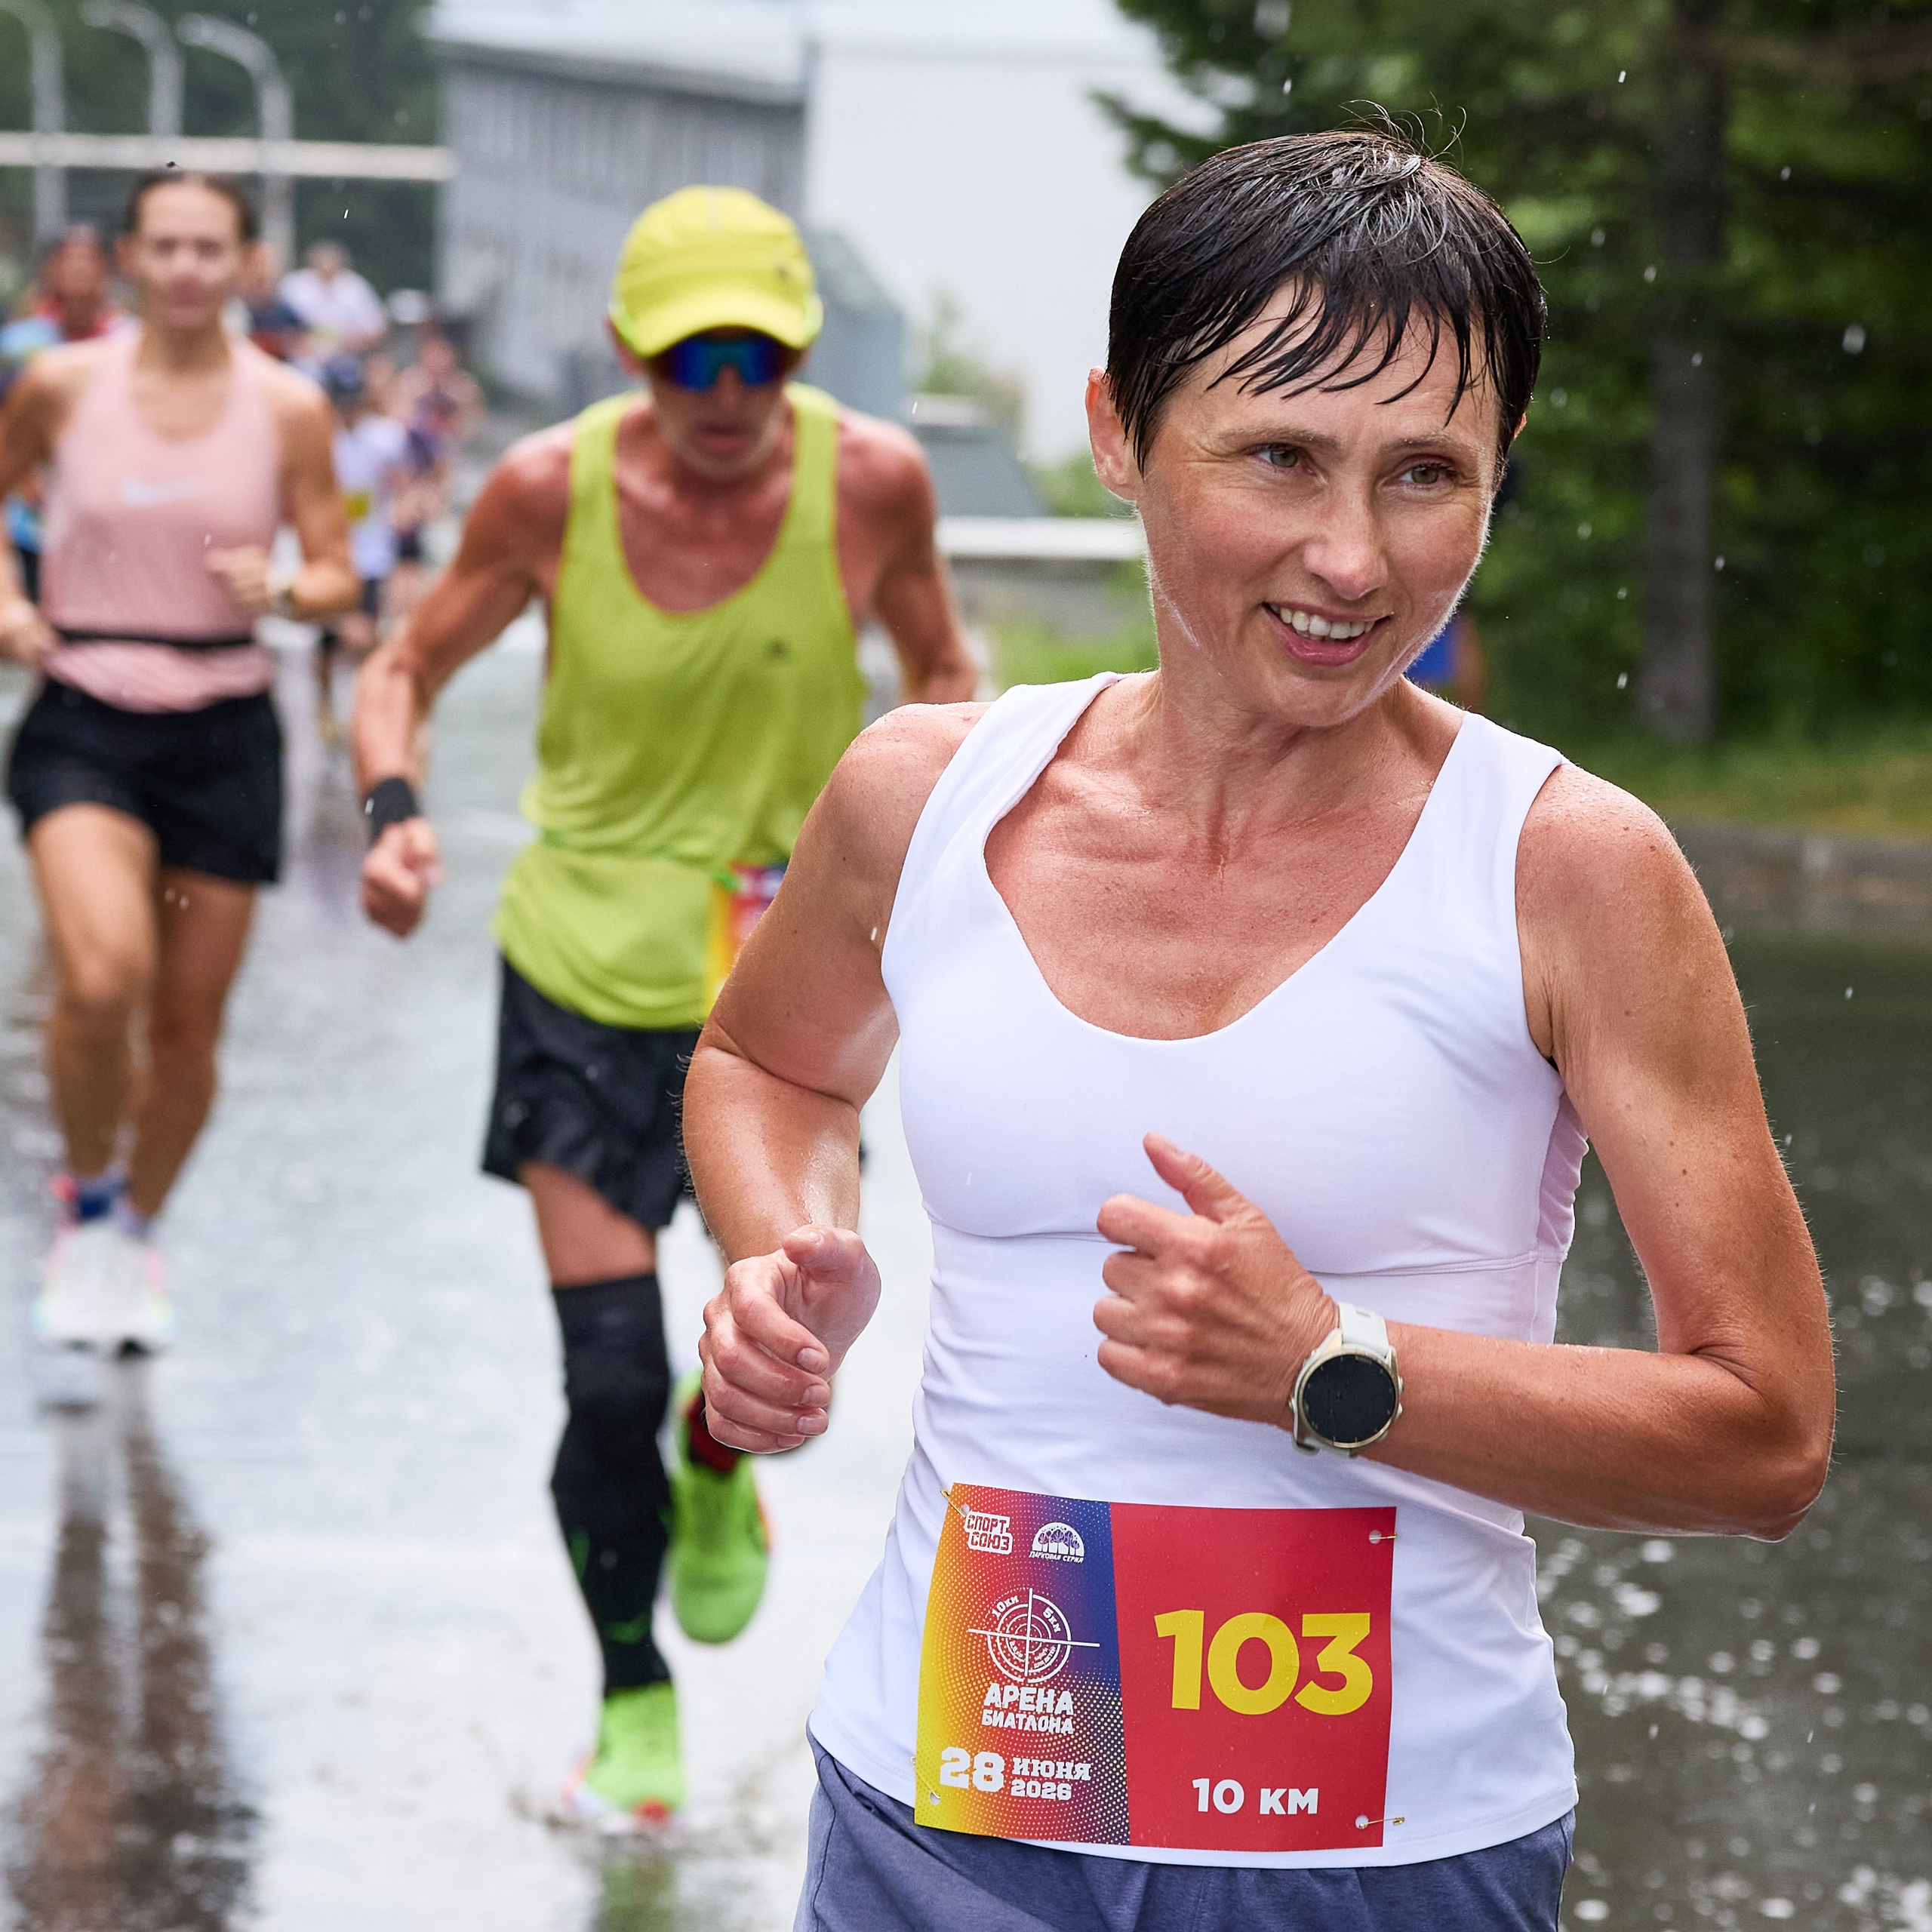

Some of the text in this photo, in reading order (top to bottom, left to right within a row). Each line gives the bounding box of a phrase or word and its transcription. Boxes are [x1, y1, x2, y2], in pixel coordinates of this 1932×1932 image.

[967, 1515, 1007, 1534] СПОРТ
[971, 1531, 1010, 1551] СОЮЗ
[1029, 1551, 1084, 1564] ПАРКОВАЯ СЕРИЯ
[1154, 1609, 1374, 1715] 103
[983, 1683, 1074, 1715] АРЕНА
[981, 1709, 1074, 1734] БИАТЛОНА
[940, 1746, 1005, 1792] 28
[1011, 1780, 1072, 1801] 2026
[1192, 1778, 1244, 1814] 10
